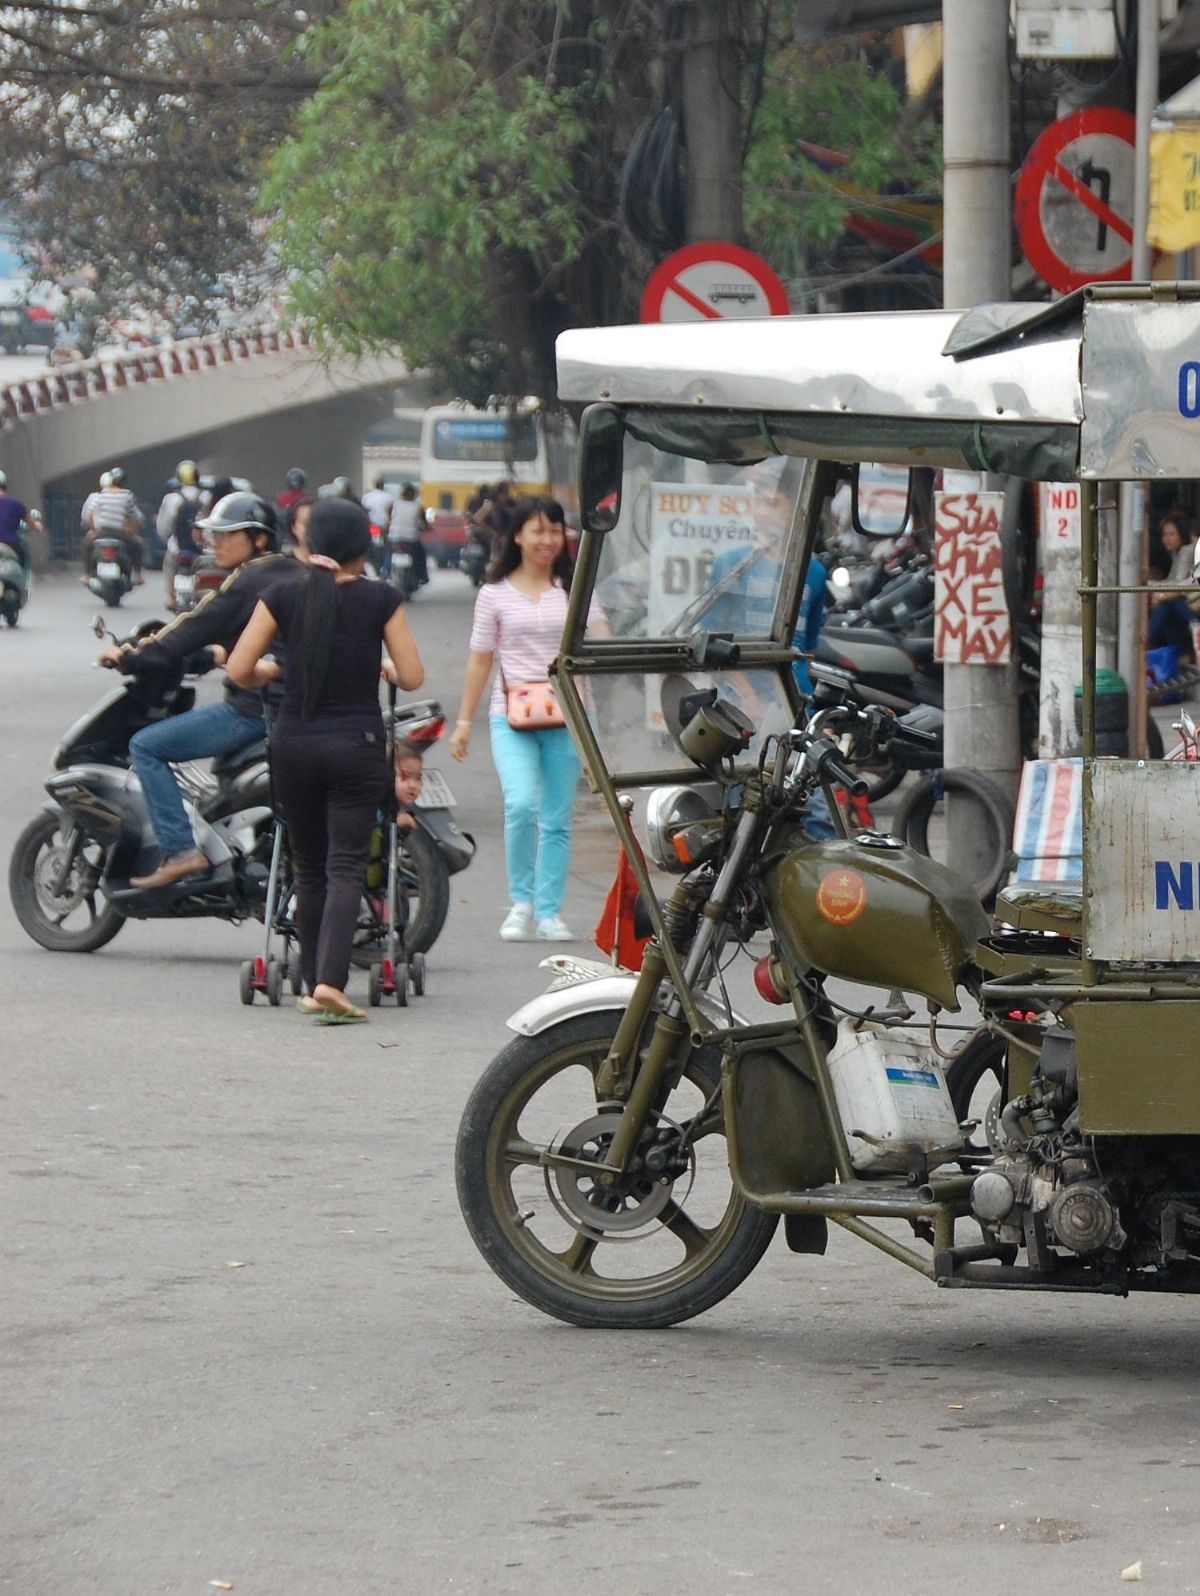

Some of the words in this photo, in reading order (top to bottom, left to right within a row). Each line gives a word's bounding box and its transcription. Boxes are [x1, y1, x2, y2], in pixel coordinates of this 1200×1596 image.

[1058, 518, 1068, 537] 2
[936, 576, 1008, 616] XE
[937, 613, 1010, 663] MÁY
